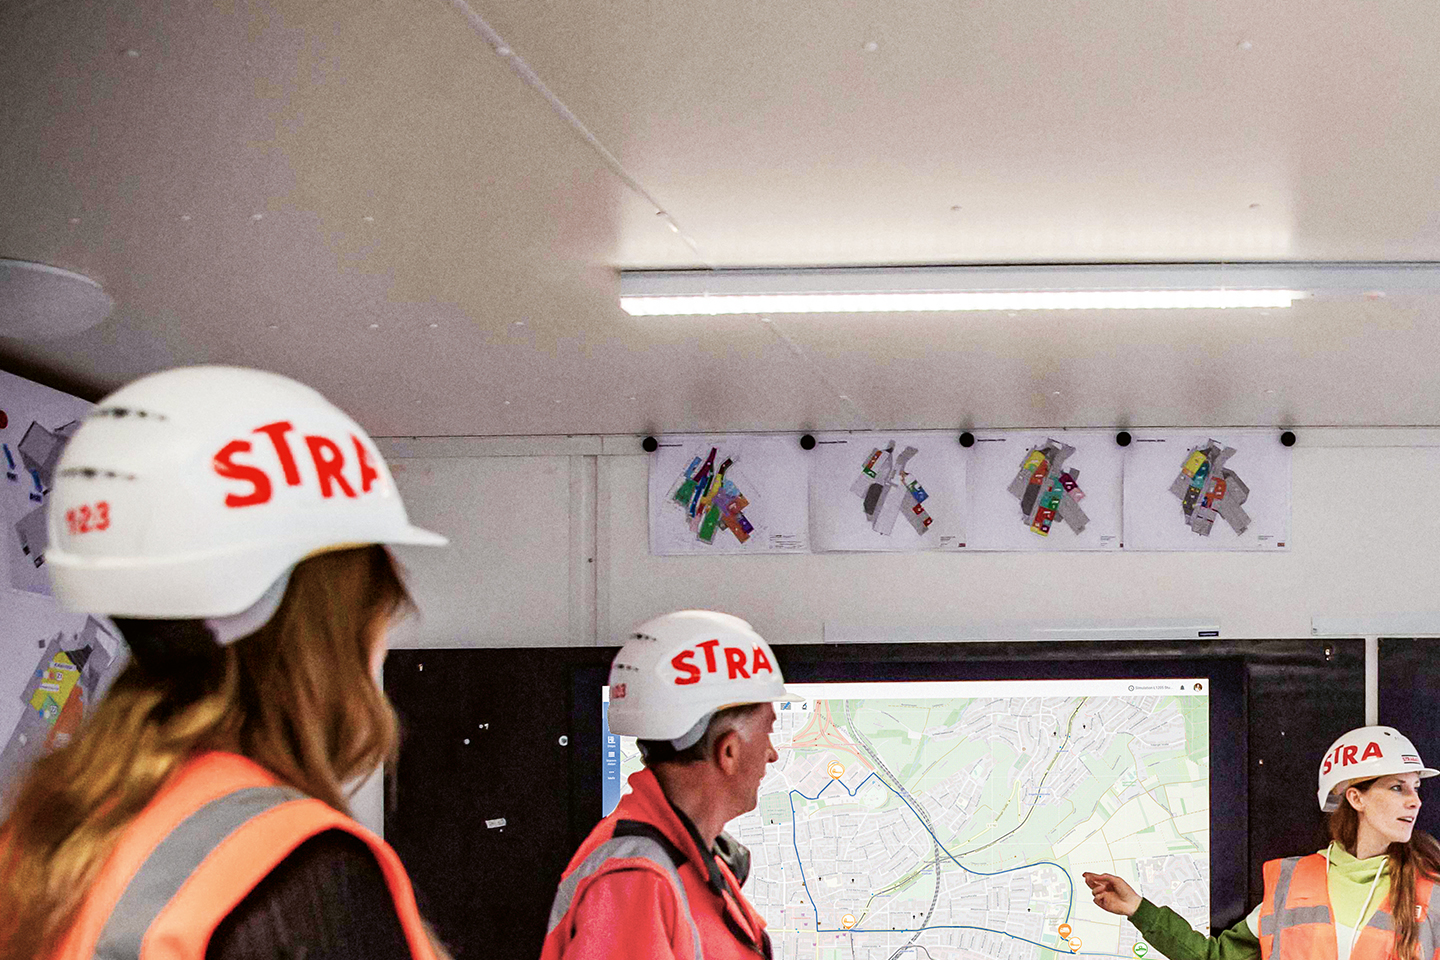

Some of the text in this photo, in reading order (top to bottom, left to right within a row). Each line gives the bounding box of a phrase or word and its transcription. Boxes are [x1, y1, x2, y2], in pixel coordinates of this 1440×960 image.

[211, 421, 385, 508] STRA
[671, 639, 772, 685] STRA
[1323, 742, 1383, 775] STRA
